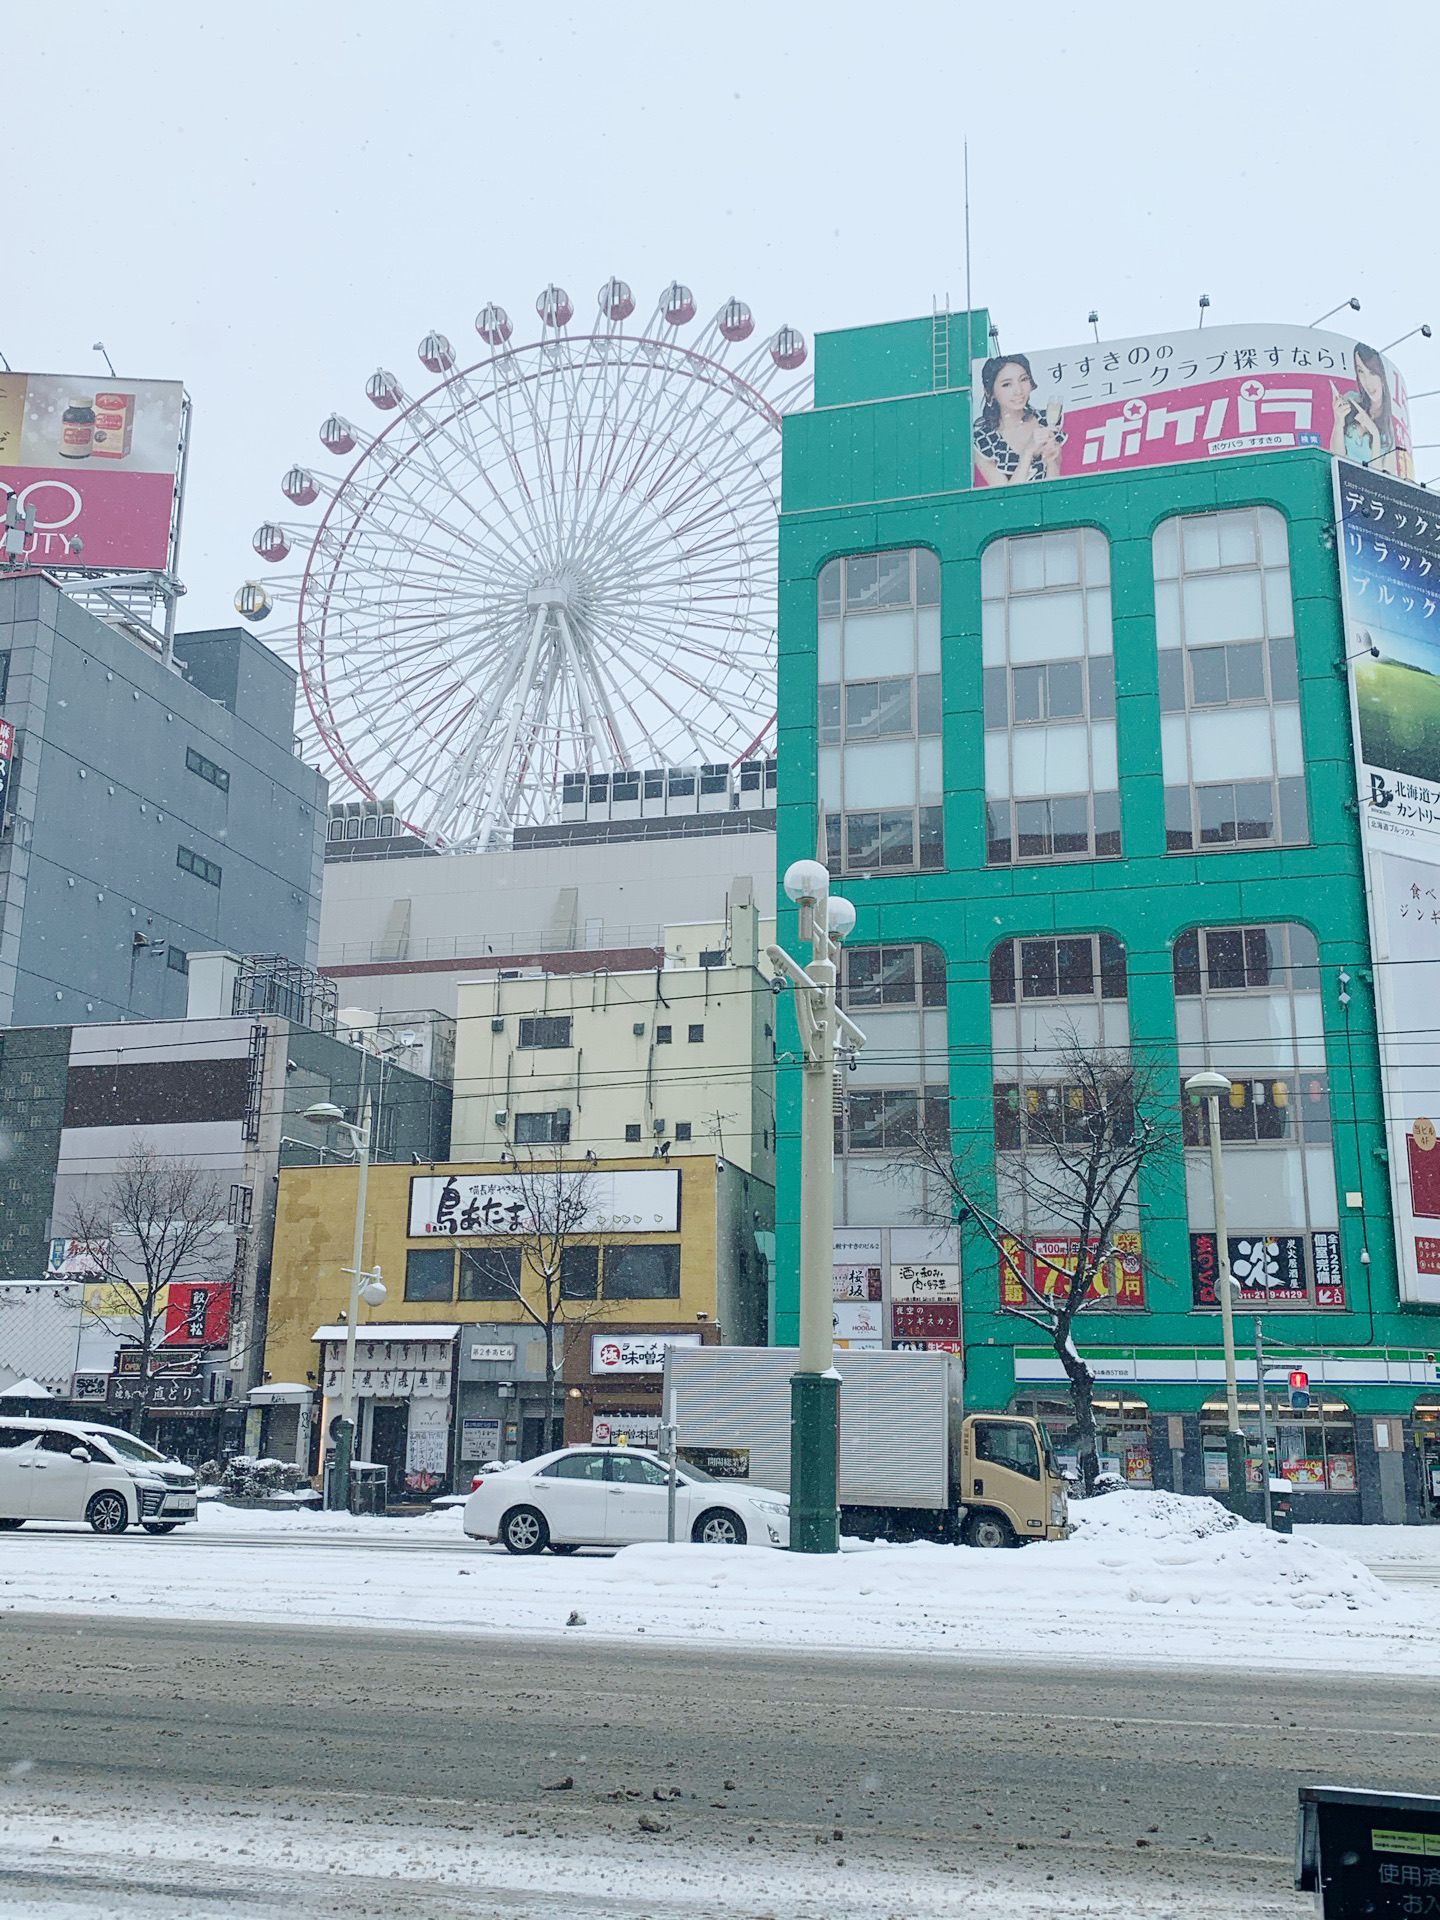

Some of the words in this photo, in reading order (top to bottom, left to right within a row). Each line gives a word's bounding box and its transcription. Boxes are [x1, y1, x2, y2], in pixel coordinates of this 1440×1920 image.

[1047, 344, 1174, 384] すすきのの
[1081, 379, 1313, 465] ポケパラ
[436, 1176, 526, 1235] 鳥あたま
[1313, 1233, 1331, 1285] 個室完備
[896, 1316, 955, 1326] ジンギスカン
[152, 1387, 193, 1401] 直どり
